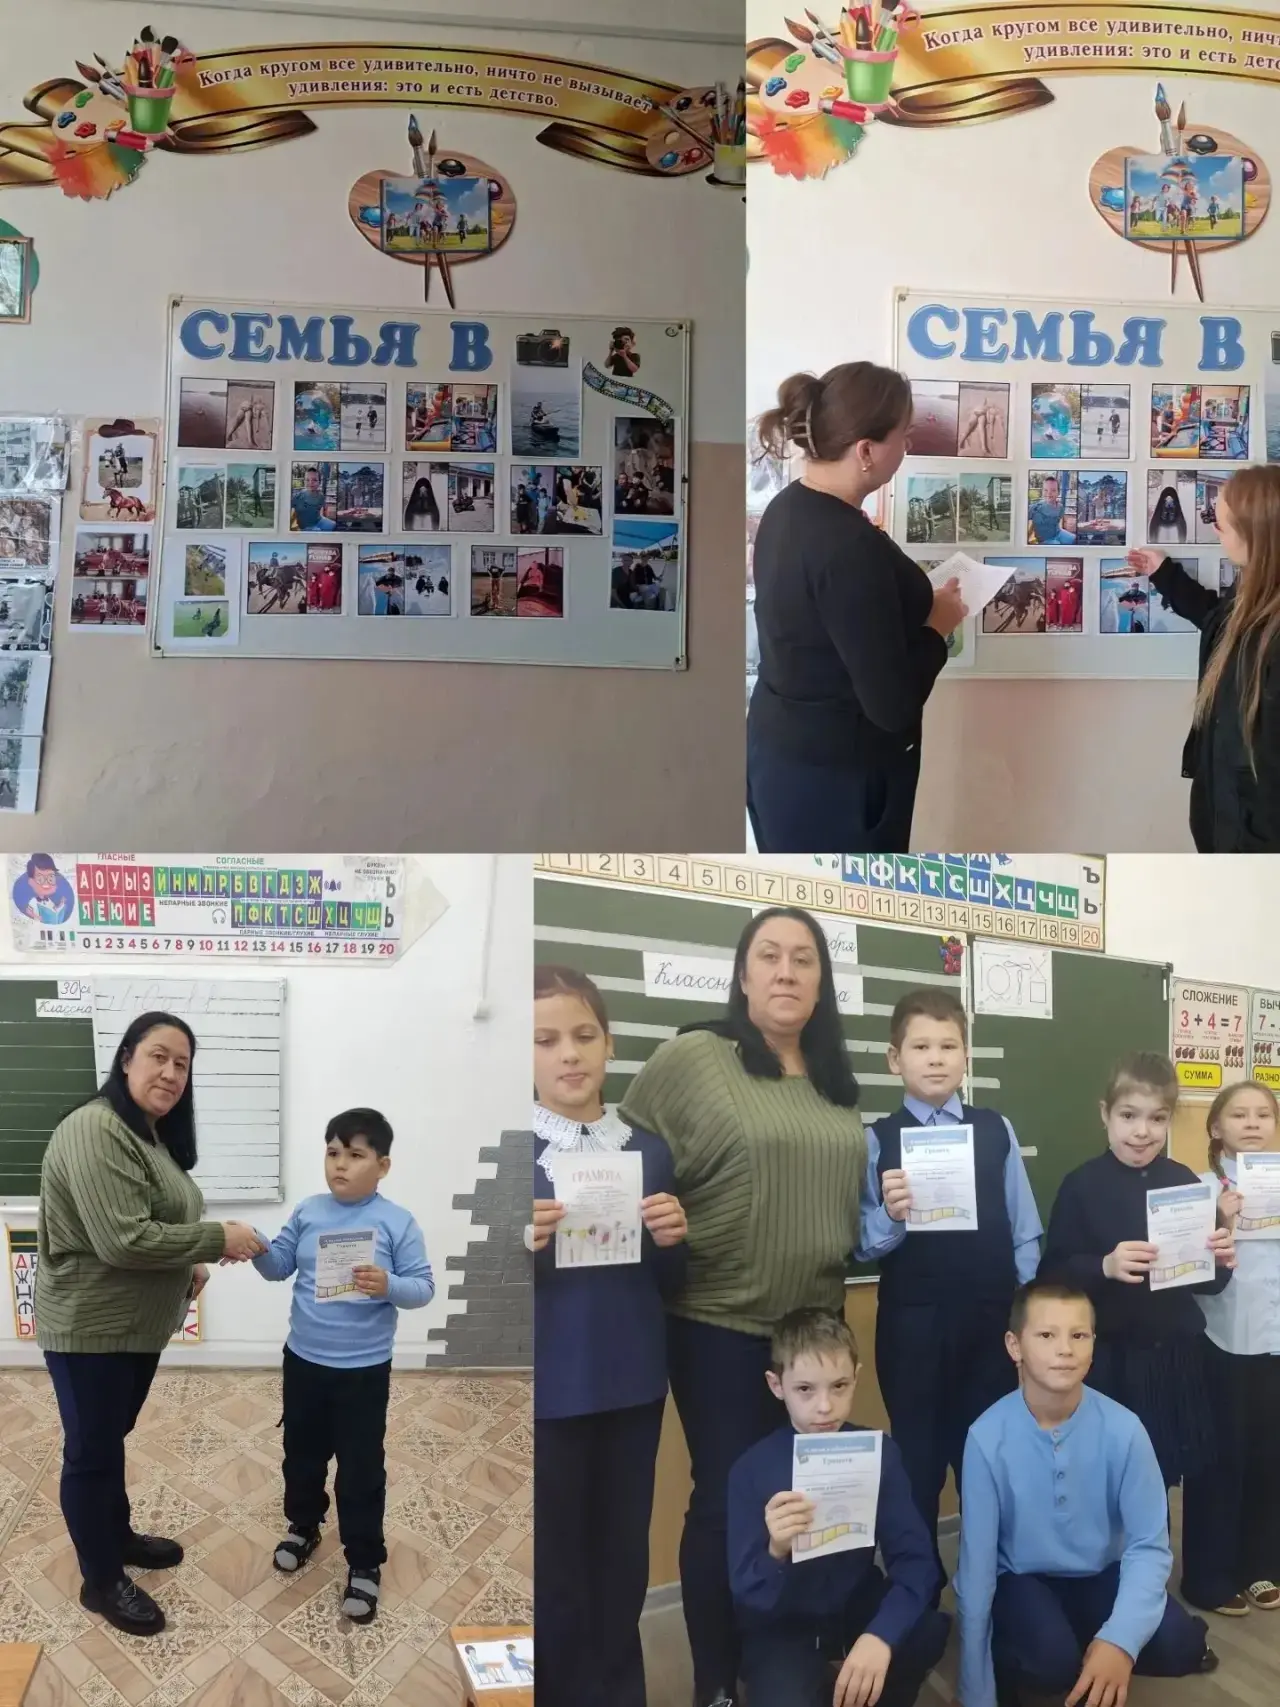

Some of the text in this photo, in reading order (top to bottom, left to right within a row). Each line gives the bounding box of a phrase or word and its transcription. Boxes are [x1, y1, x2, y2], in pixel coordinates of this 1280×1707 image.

[924, 26, 984, 50] Когда
[992, 20, 1060, 39] кругом
[1069, 20, 1098, 32] все
[1107, 20, 1233, 41] удивительно,
[1024, 45, 1134, 62] удивления:
[1143, 46, 1171, 58] это
[1180, 49, 1190, 60] и
[1199, 50, 1236, 64] есть
[199, 60, 652, 113] Когда кругом все удивительно, ничто не вызывает
[289, 82, 558, 107] удивления: это и есть детство.
[180, 308, 494, 372] СЕМЬЯ В
[906, 304, 1246, 372] СЕМЬЯ В
[216, 856, 265, 865] СОГЛАСНЫЕ
[80, 870, 89, 889] А
[95, 870, 104, 889] О
[110, 872, 120, 890] У
[125, 872, 136, 890] Ы
[142, 872, 151, 890] Э
[158, 868, 166, 892] Й
[173, 874, 181, 891] Н
[188, 874, 197, 891] М
[203, 874, 212, 891] Л
[219, 874, 227, 891] Р
[235, 875, 243, 892] Б
[250, 875, 257, 893] В
[265, 876, 272, 893] Г
[280, 875, 289, 895] Д
[296, 875, 303, 894] З
[309, 876, 321, 895] Ж
[845, 856, 1100, 917] П Ф К Т С Ш Х Ц Ч Щ Ъ
[599, 854, 611, 871] 2
[633, 859, 645, 876] 3
[669, 865, 681, 881] 4
[702, 869, 713, 885] 5
[736, 874, 746, 891] 6
[765, 879, 775, 895] 7
[796, 884, 807, 900] 8
[823, 888, 834, 904] 9
[848, 893, 866, 909] 10
[876, 898, 891, 913] 11
[901, 903, 919, 918] 12
[926, 906, 943, 921] 13
[951, 910, 967, 924] 14
[975, 914, 991, 928] 15
[998, 918, 1013, 931] 16
[1020, 921, 1035, 934] 17
[1043, 924, 1057, 938] 18
[1063, 927, 1077, 941] 19
[1084, 930, 1099, 944] 20
[1084, 898, 1098, 914] Ь
[82, 901, 151, 921] Я Ё Ю И Е
[235, 903, 394, 927] П Ф К Т С Ш Х Ц Ч Щ Ь
[83, 938, 90, 948] 0
[95, 938, 100, 948] 1
[105, 938, 113, 948] 2
[117, 938, 124, 948] 3
[129, 938, 136, 949] 4
[141, 938, 147, 949] 5
[152, 938, 160, 949] 6
[164, 939, 171, 949] 7
[176, 940, 183, 950] 8
[187, 940, 194, 950] 9
[199, 940, 213, 950] 10
[218, 940, 229, 950] 11
[234, 941, 248, 951] 12
[252, 941, 266, 952] 13
[271, 942, 284, 952] 14
[290, 942, 303, 953] 15
[308, 943, 321, 953] 16
[326, 943, 339, 953] 17
[343, 943, 356, 954] 18
[361, 944, 374, 954] 19
[379, 944, 394, 954] 20
[654, 961, 732, 990] Классн
[60, 982, 78, 994] 30
[1182, 989, 1238, 1006] СЛОЖЕНИЕ
[1181, 1010, 1189, 1027] 3
[1208, 1012, 1216, 1030] 4
[1234, 1016, 1242, 1032] 7
[1259, 1014, 1266, 1030] 7
[1184, 1070, 1213, 1080] СУММА
[1255, 1072, 1280, 1082] РАЗНО
[572, 1168, 622, 1182] ГРАМОТА
[16, 1254, 28, 1269] А
[14, 1270, 29, 1284] Ж
[16, 1285, 32, 1299] Н
[19, 1315, 35, 1335] Ы
